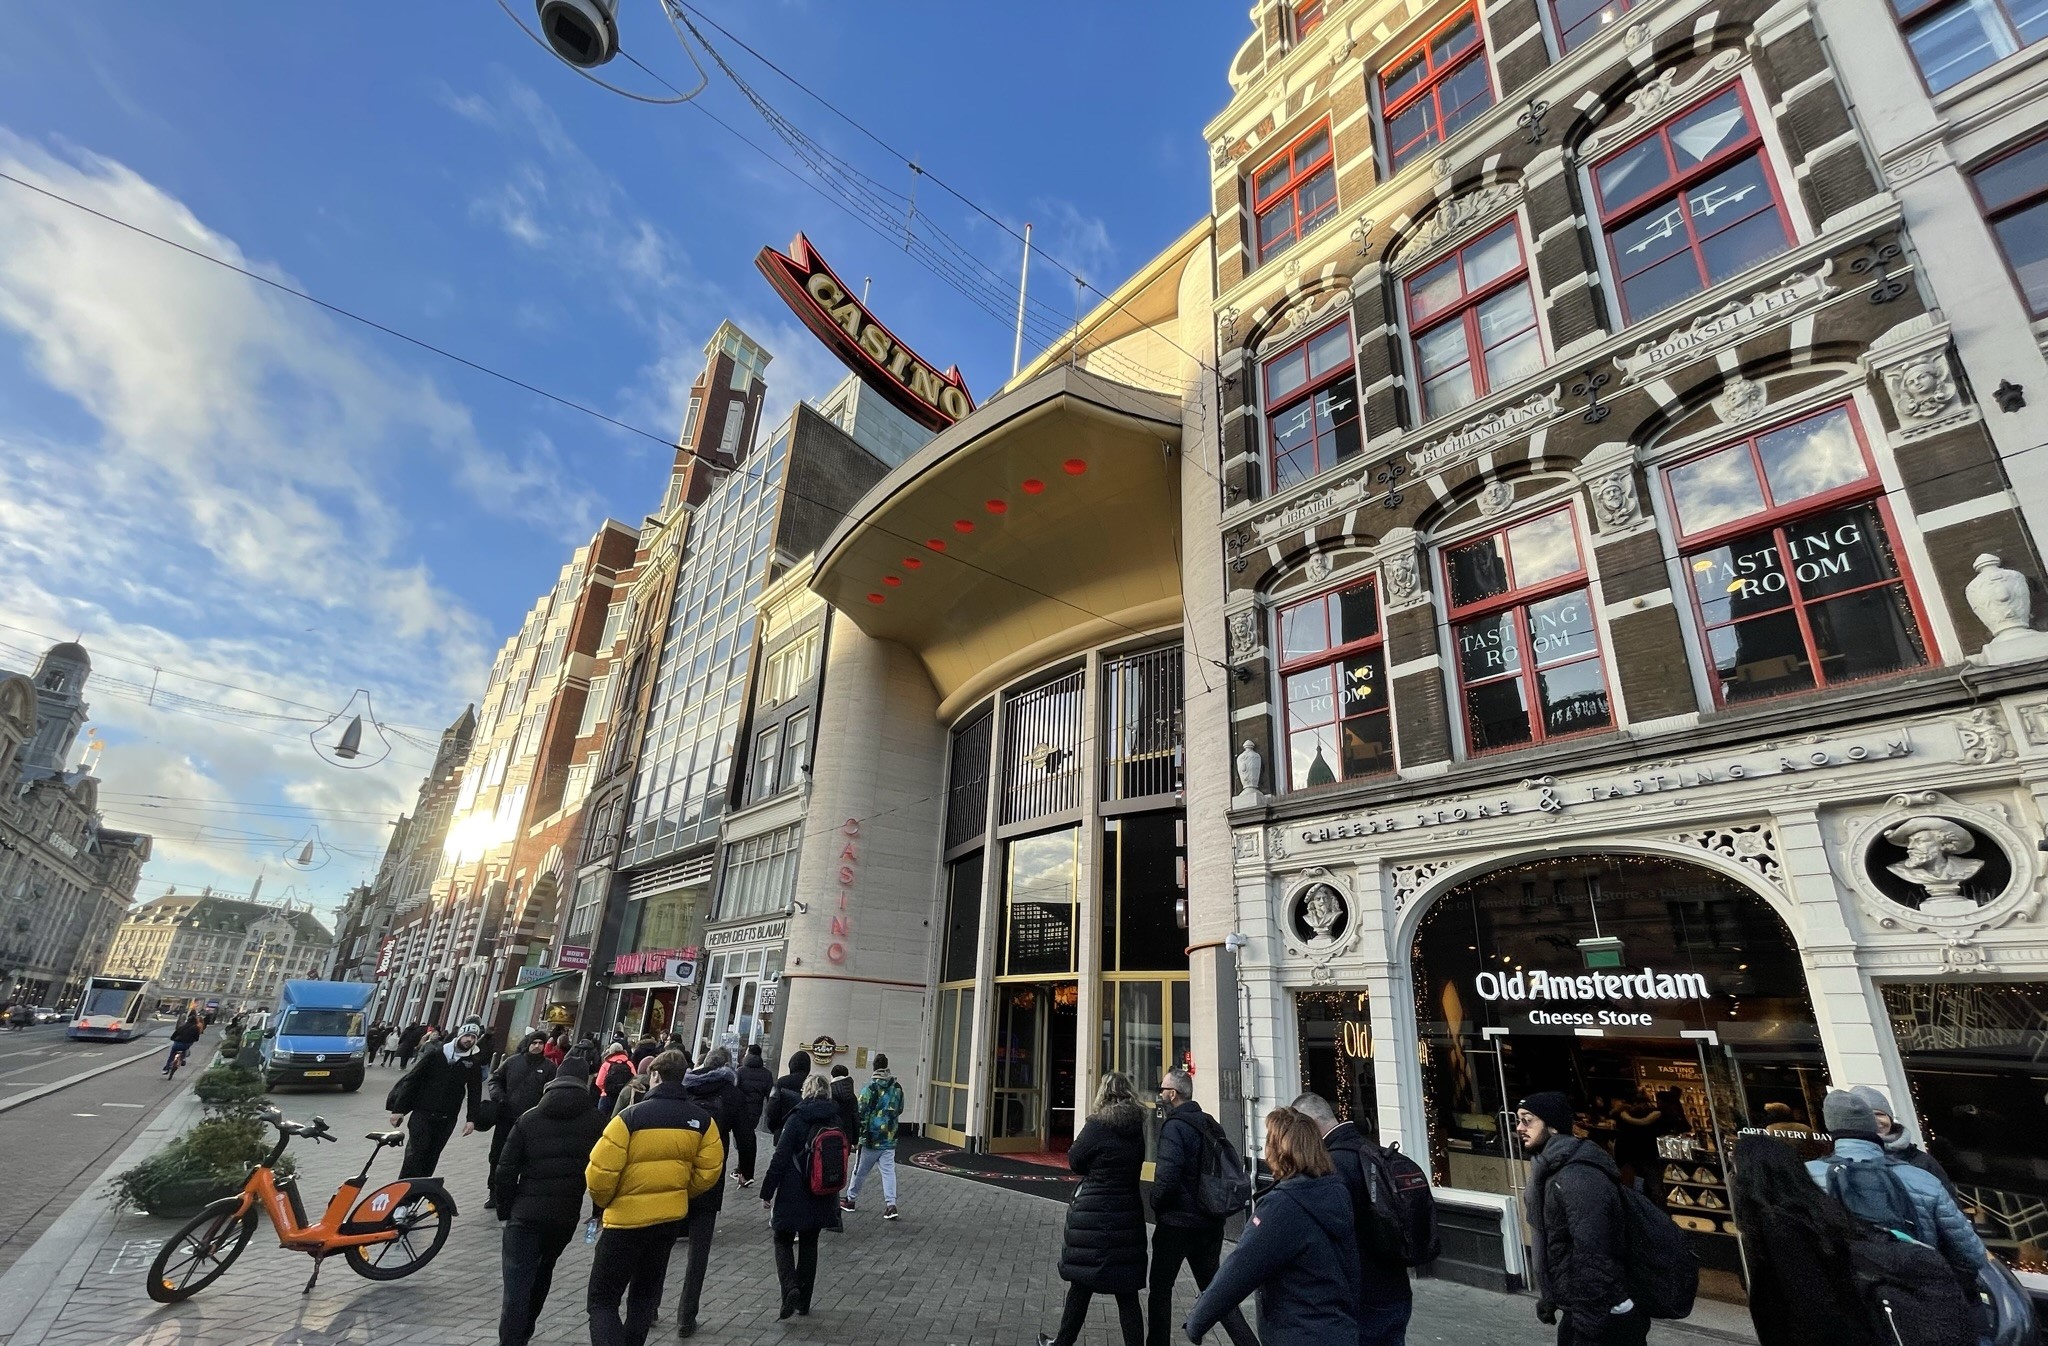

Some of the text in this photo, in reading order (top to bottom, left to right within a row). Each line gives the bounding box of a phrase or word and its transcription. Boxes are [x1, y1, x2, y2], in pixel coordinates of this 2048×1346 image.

[1649, 287, 1800, 364] BOOKSELLER
[806, 272, 970, 420] CASINO
[1423, 399, 1546, 463] BUCHHANDLUNG
[1700, 524, 1861, 586] TASTING
[1740, 551, 1852, 600] ROOM
[1460, 606, 1577, 652] TASTING
[1486, 629, 1570, 668] ROOM
[1291, 664, 1374, 699] TASTING
[1310, 685, 1367, 713] ROOM
[1301, 727, 1914, 843] CHEESE STORE & TASTING ROOM
[827, 818, 860, 962] CASINO
[732, 926, 757, 943] DELFTS
[561, 955, 588, 965] WORLDS
[566, 950, 585, 958] BODY
[525, 968, 547, 977] TULIP
[1475, 967, 1711, 1001] Old Amsterdam
[1528, 1009, 1652, 1026] Cheese Store
[1343, 1020, 1369, 1059] Old
[1657, 1065, 1695, 1074] TASTING
[1676, 1072, 1704, 1080] THEAT
[1742, 1127, 1833, 1142] OPEN EVERY DAY
